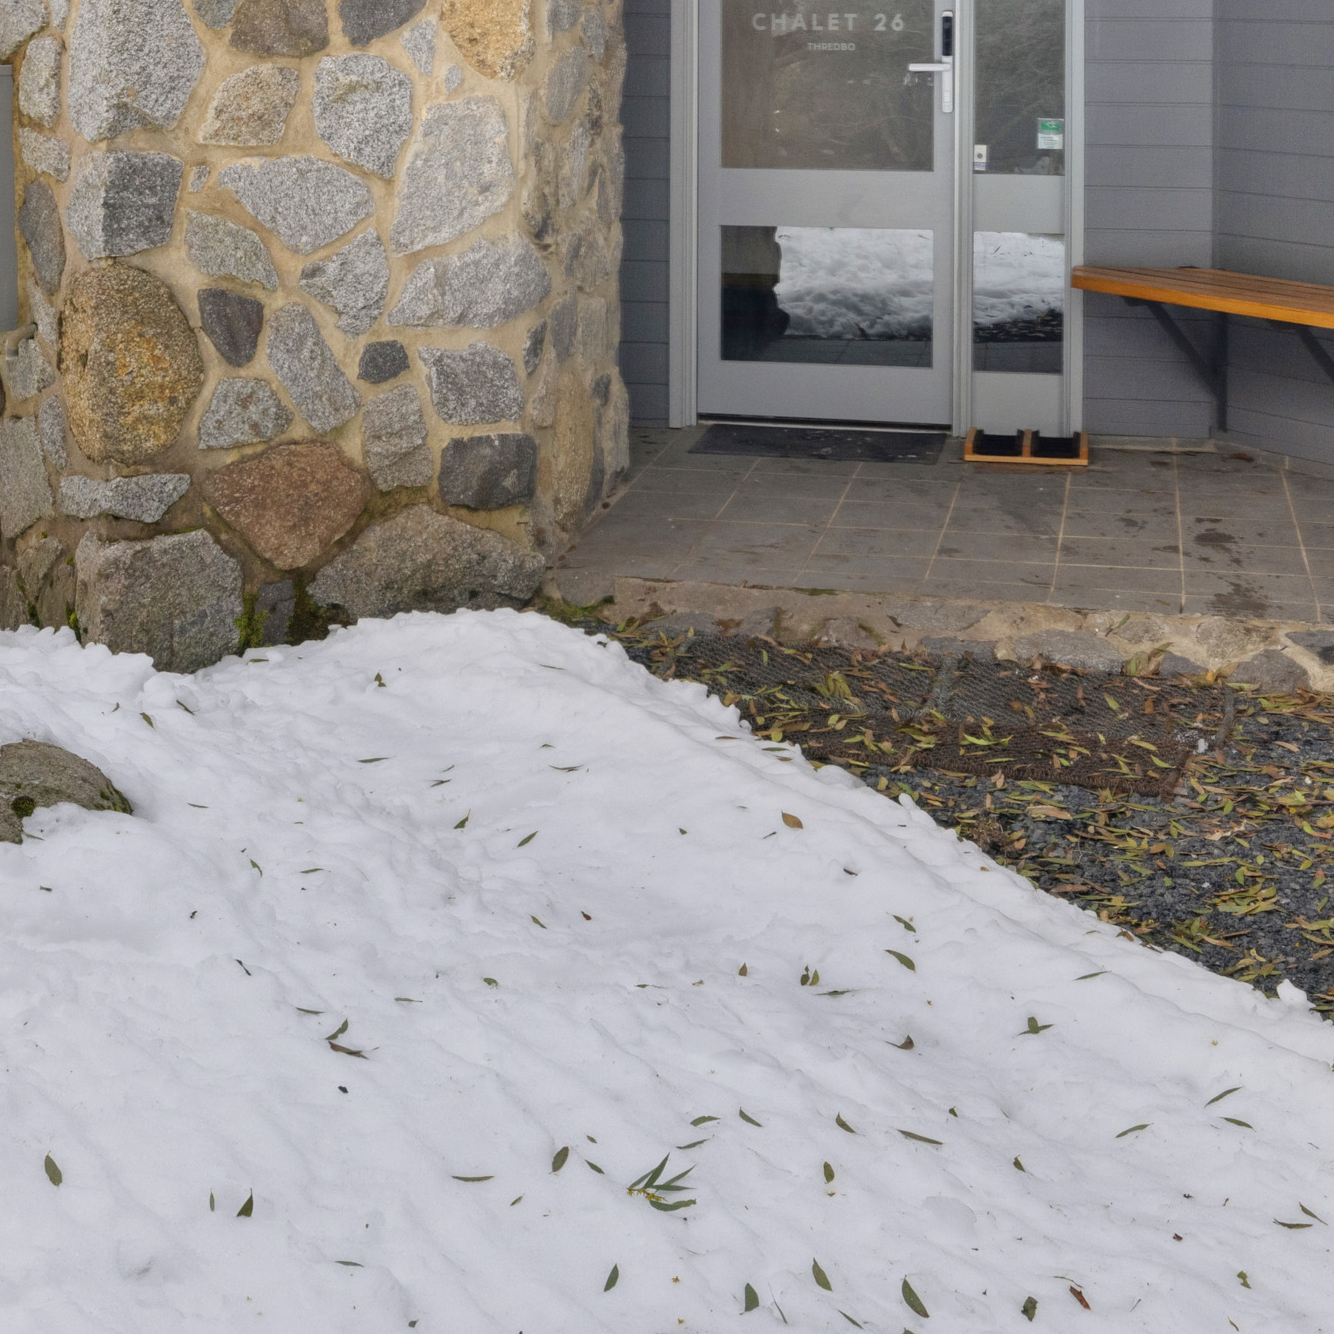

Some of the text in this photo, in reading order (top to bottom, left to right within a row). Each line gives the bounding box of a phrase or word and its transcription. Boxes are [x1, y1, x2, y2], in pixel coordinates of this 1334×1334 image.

[752, 12, 905, 32] CHALET 26
[807, 42, 856, 51] THREDBO
